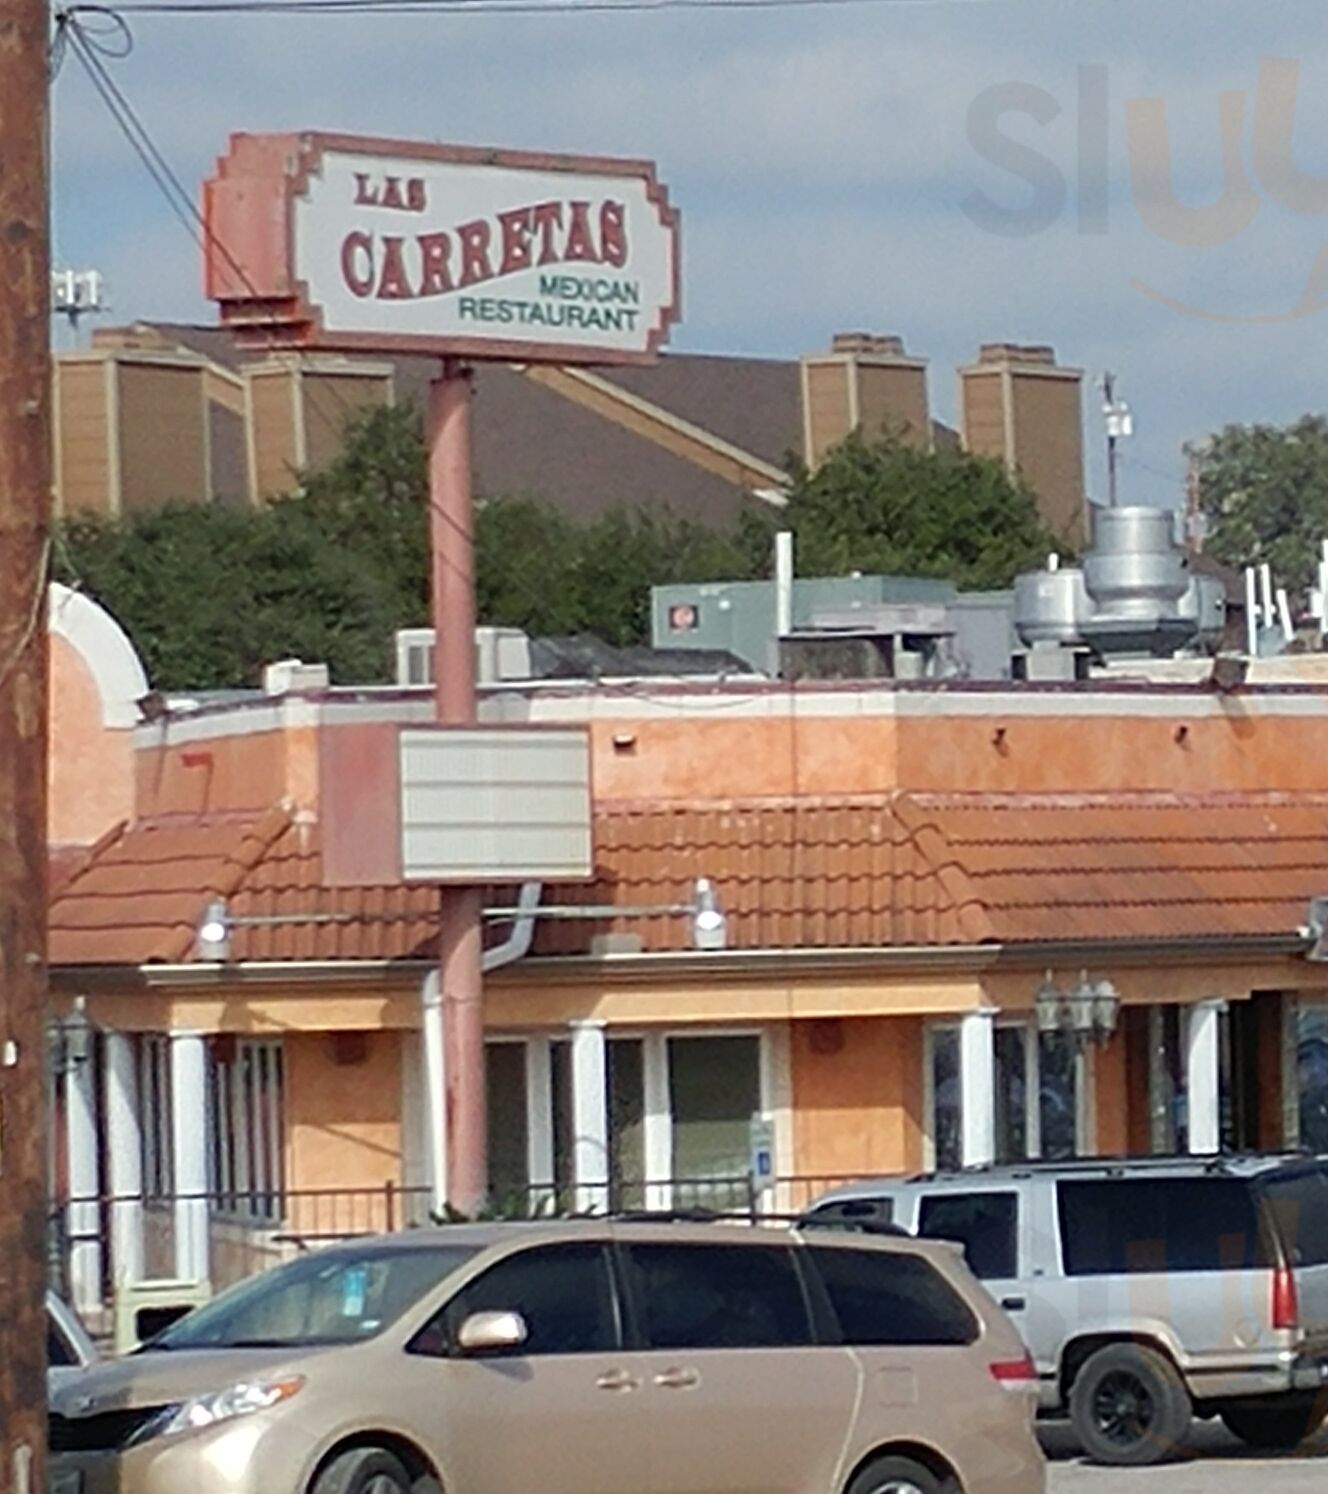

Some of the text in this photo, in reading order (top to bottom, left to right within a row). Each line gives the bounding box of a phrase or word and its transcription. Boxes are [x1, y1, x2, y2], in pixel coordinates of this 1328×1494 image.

[353, 172, 427, 213] LAS
[340, 199, 628, 300] CARRETAS
[538, 274, 640, 304] MEXICAN
[458, 297, 640, 332] RESTAURANT
